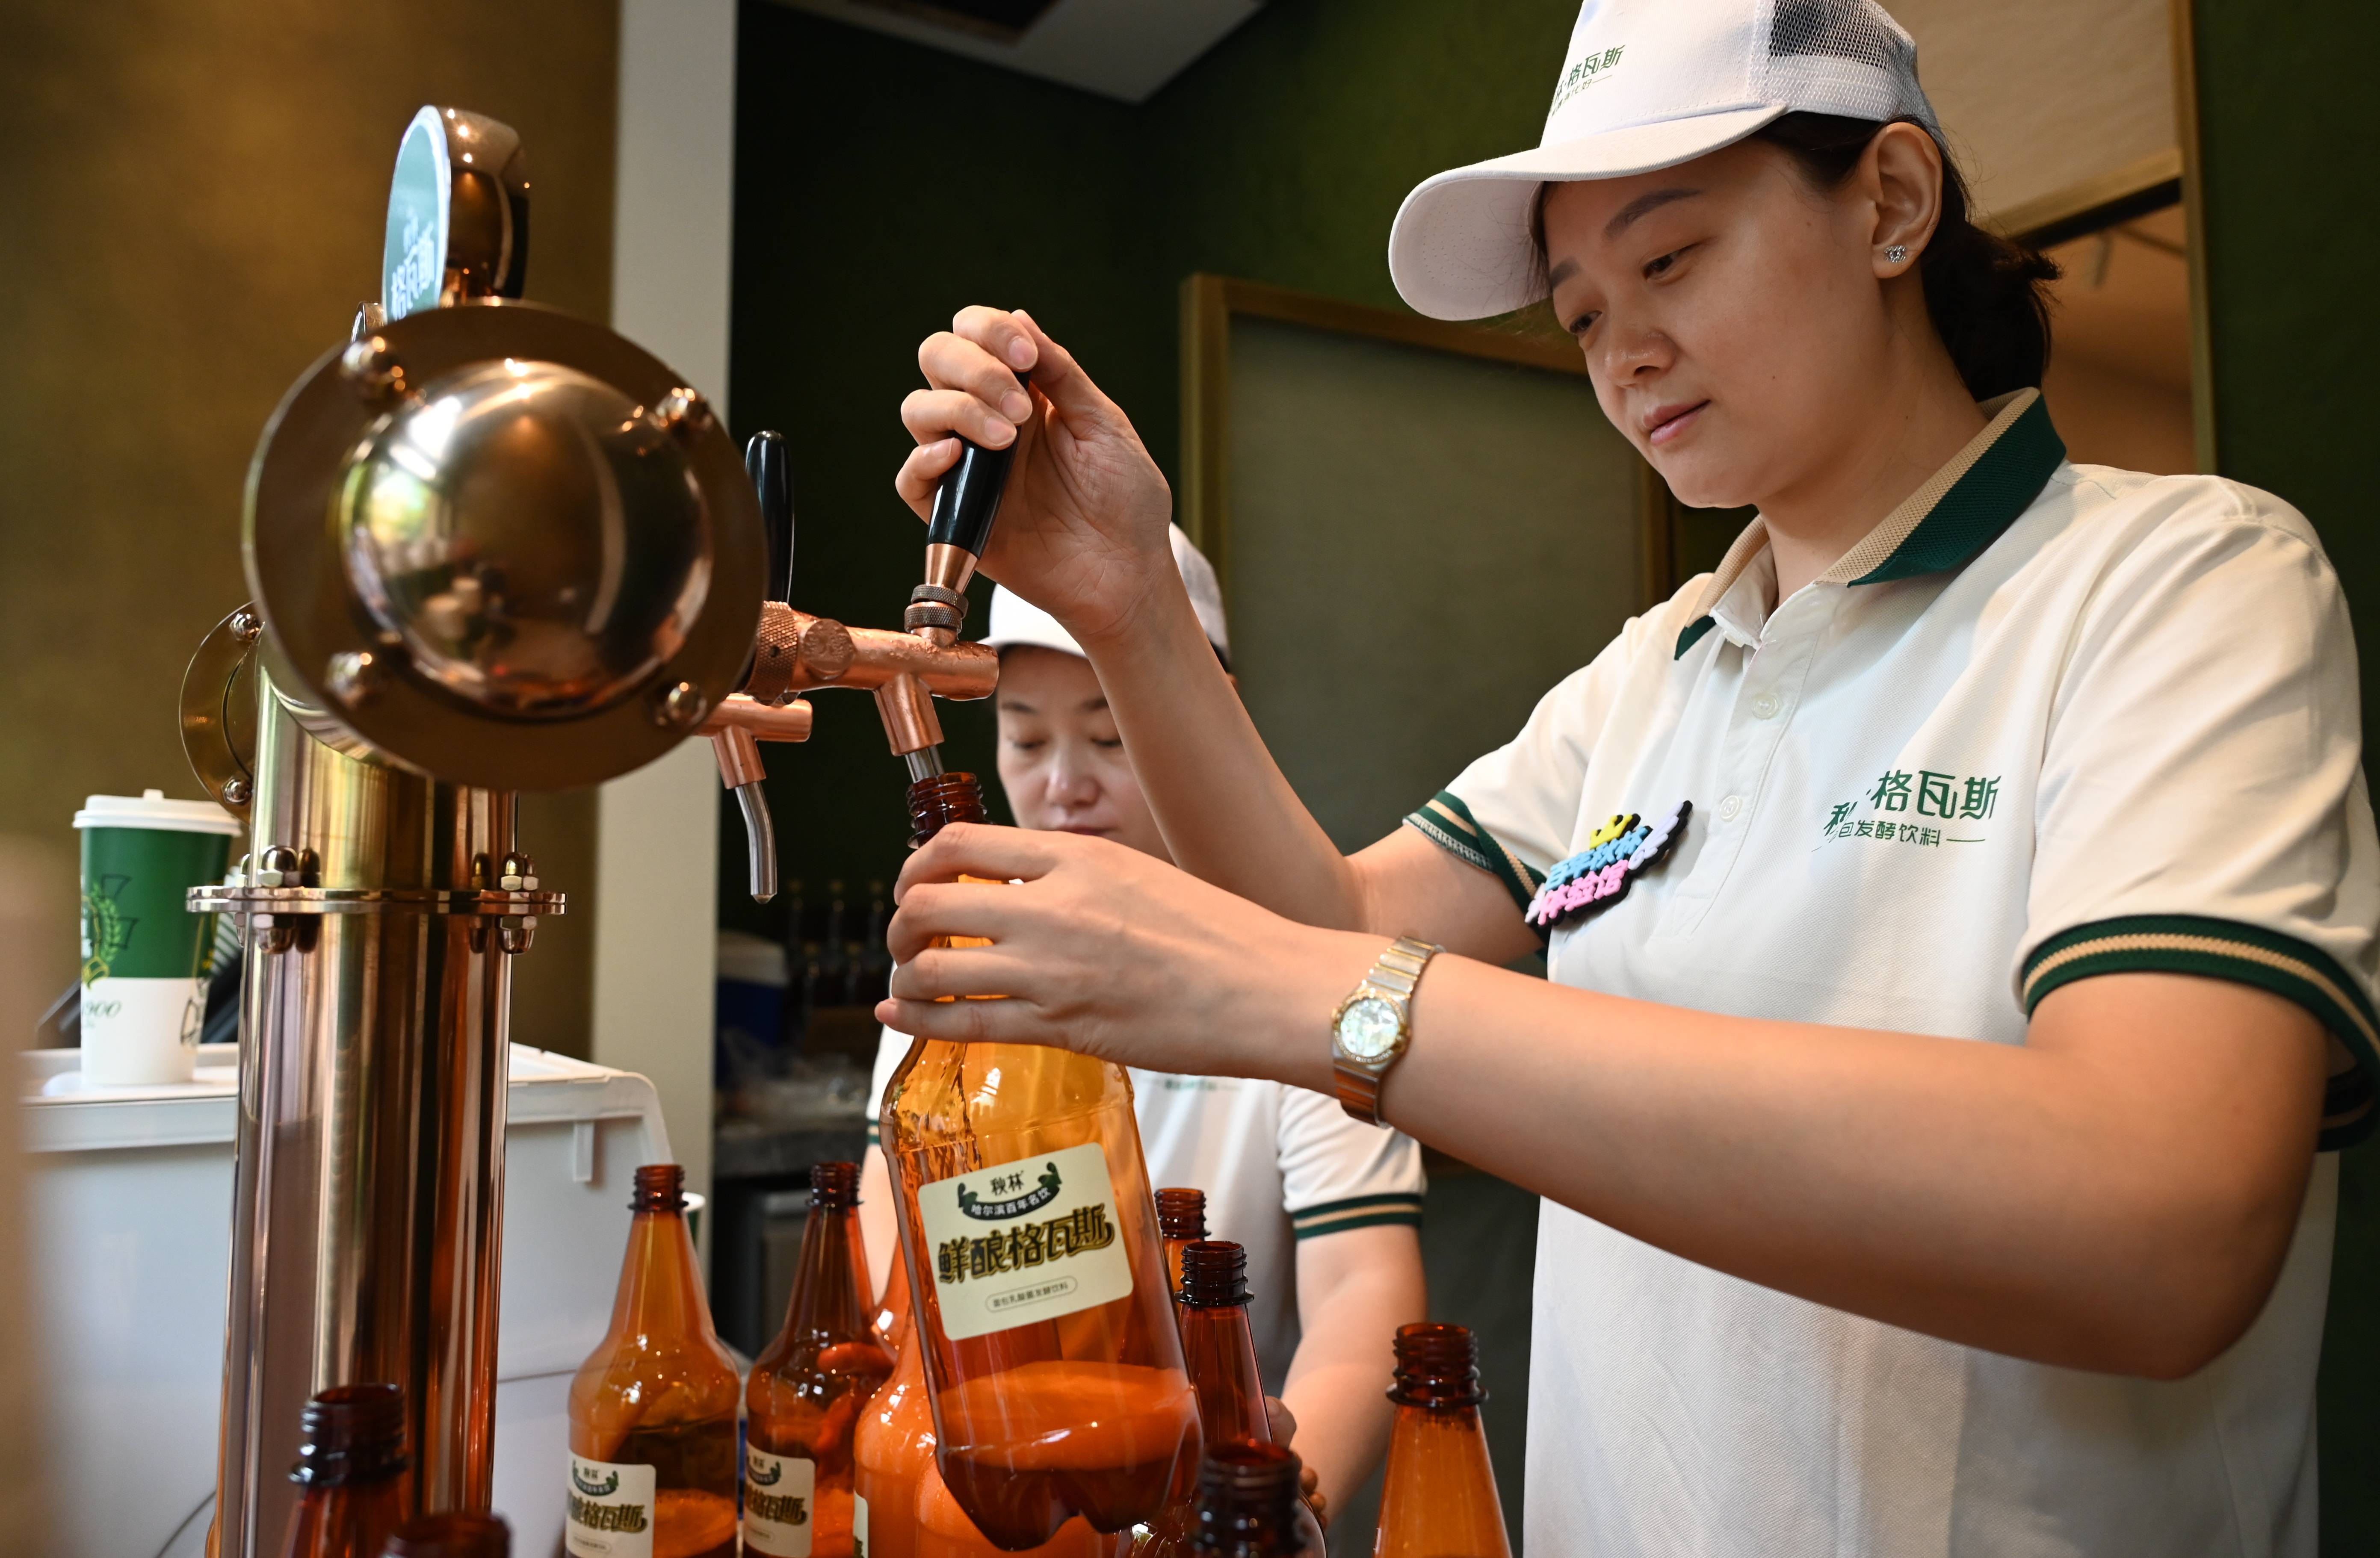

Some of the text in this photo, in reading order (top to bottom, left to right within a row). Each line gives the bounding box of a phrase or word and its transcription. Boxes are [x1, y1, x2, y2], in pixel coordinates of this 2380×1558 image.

[1828, 820, 1941, 847] 包发酵饮料
[990, 1172, 1024, 1195] 秋林
[971, 1186, 1051, 1216] 哈尔滨百年名饮
[938, 1203, 1115, 1284] 鲜酿格瓦斯
